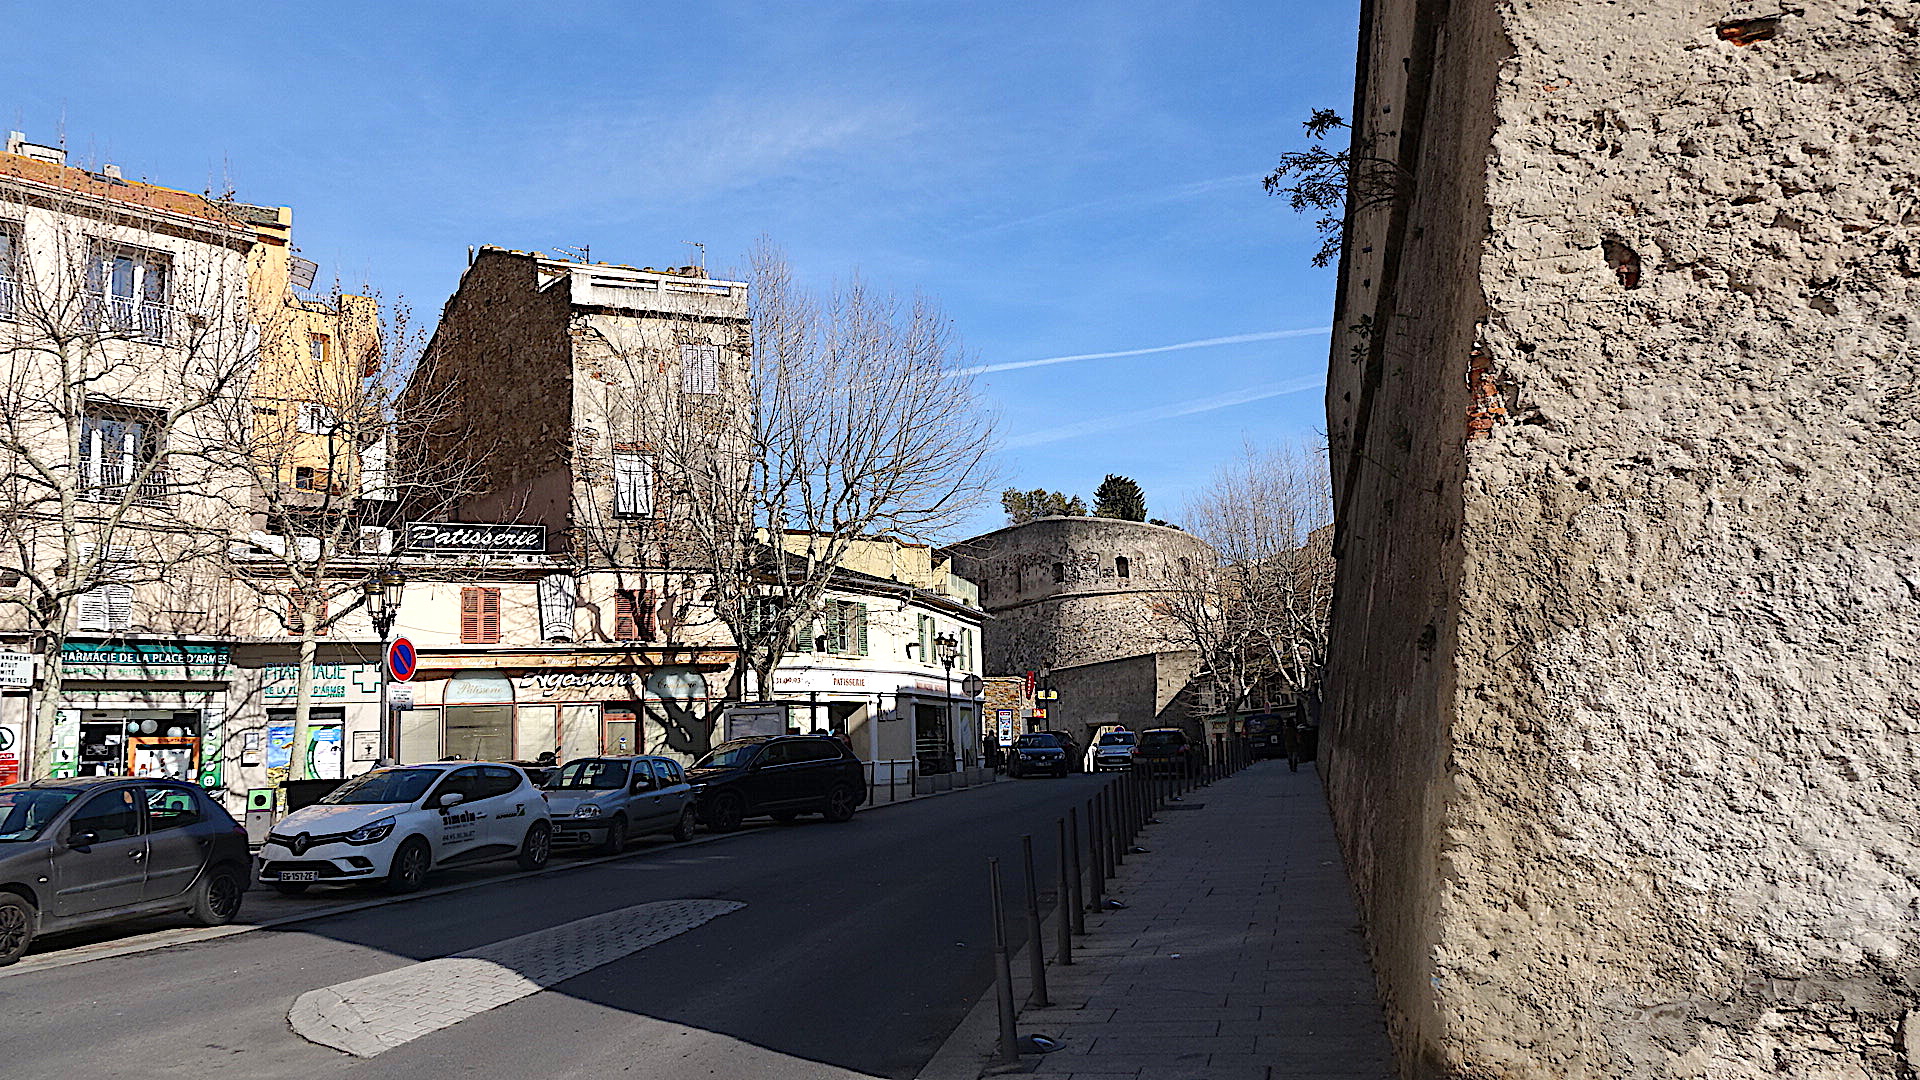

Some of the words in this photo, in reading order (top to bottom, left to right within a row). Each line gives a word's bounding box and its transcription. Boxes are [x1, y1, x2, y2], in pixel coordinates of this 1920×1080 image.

[411, 525, 540, 545] Patisserie
[61, 651, 118, 663] HARMACIE
[119, 652, 134, 663] DE
[136, 653, 151, 663] LA
[152, 653, 184, 664] PLACE
[186, 654, 229, 665] D'ARMES
[264, 661, 347, 681] PHARACIE
[833, 677, 866, 687] PATISSERIE
[276, 685, 286, 695] LA
[313, 685, 346, 694] D'ARMES
